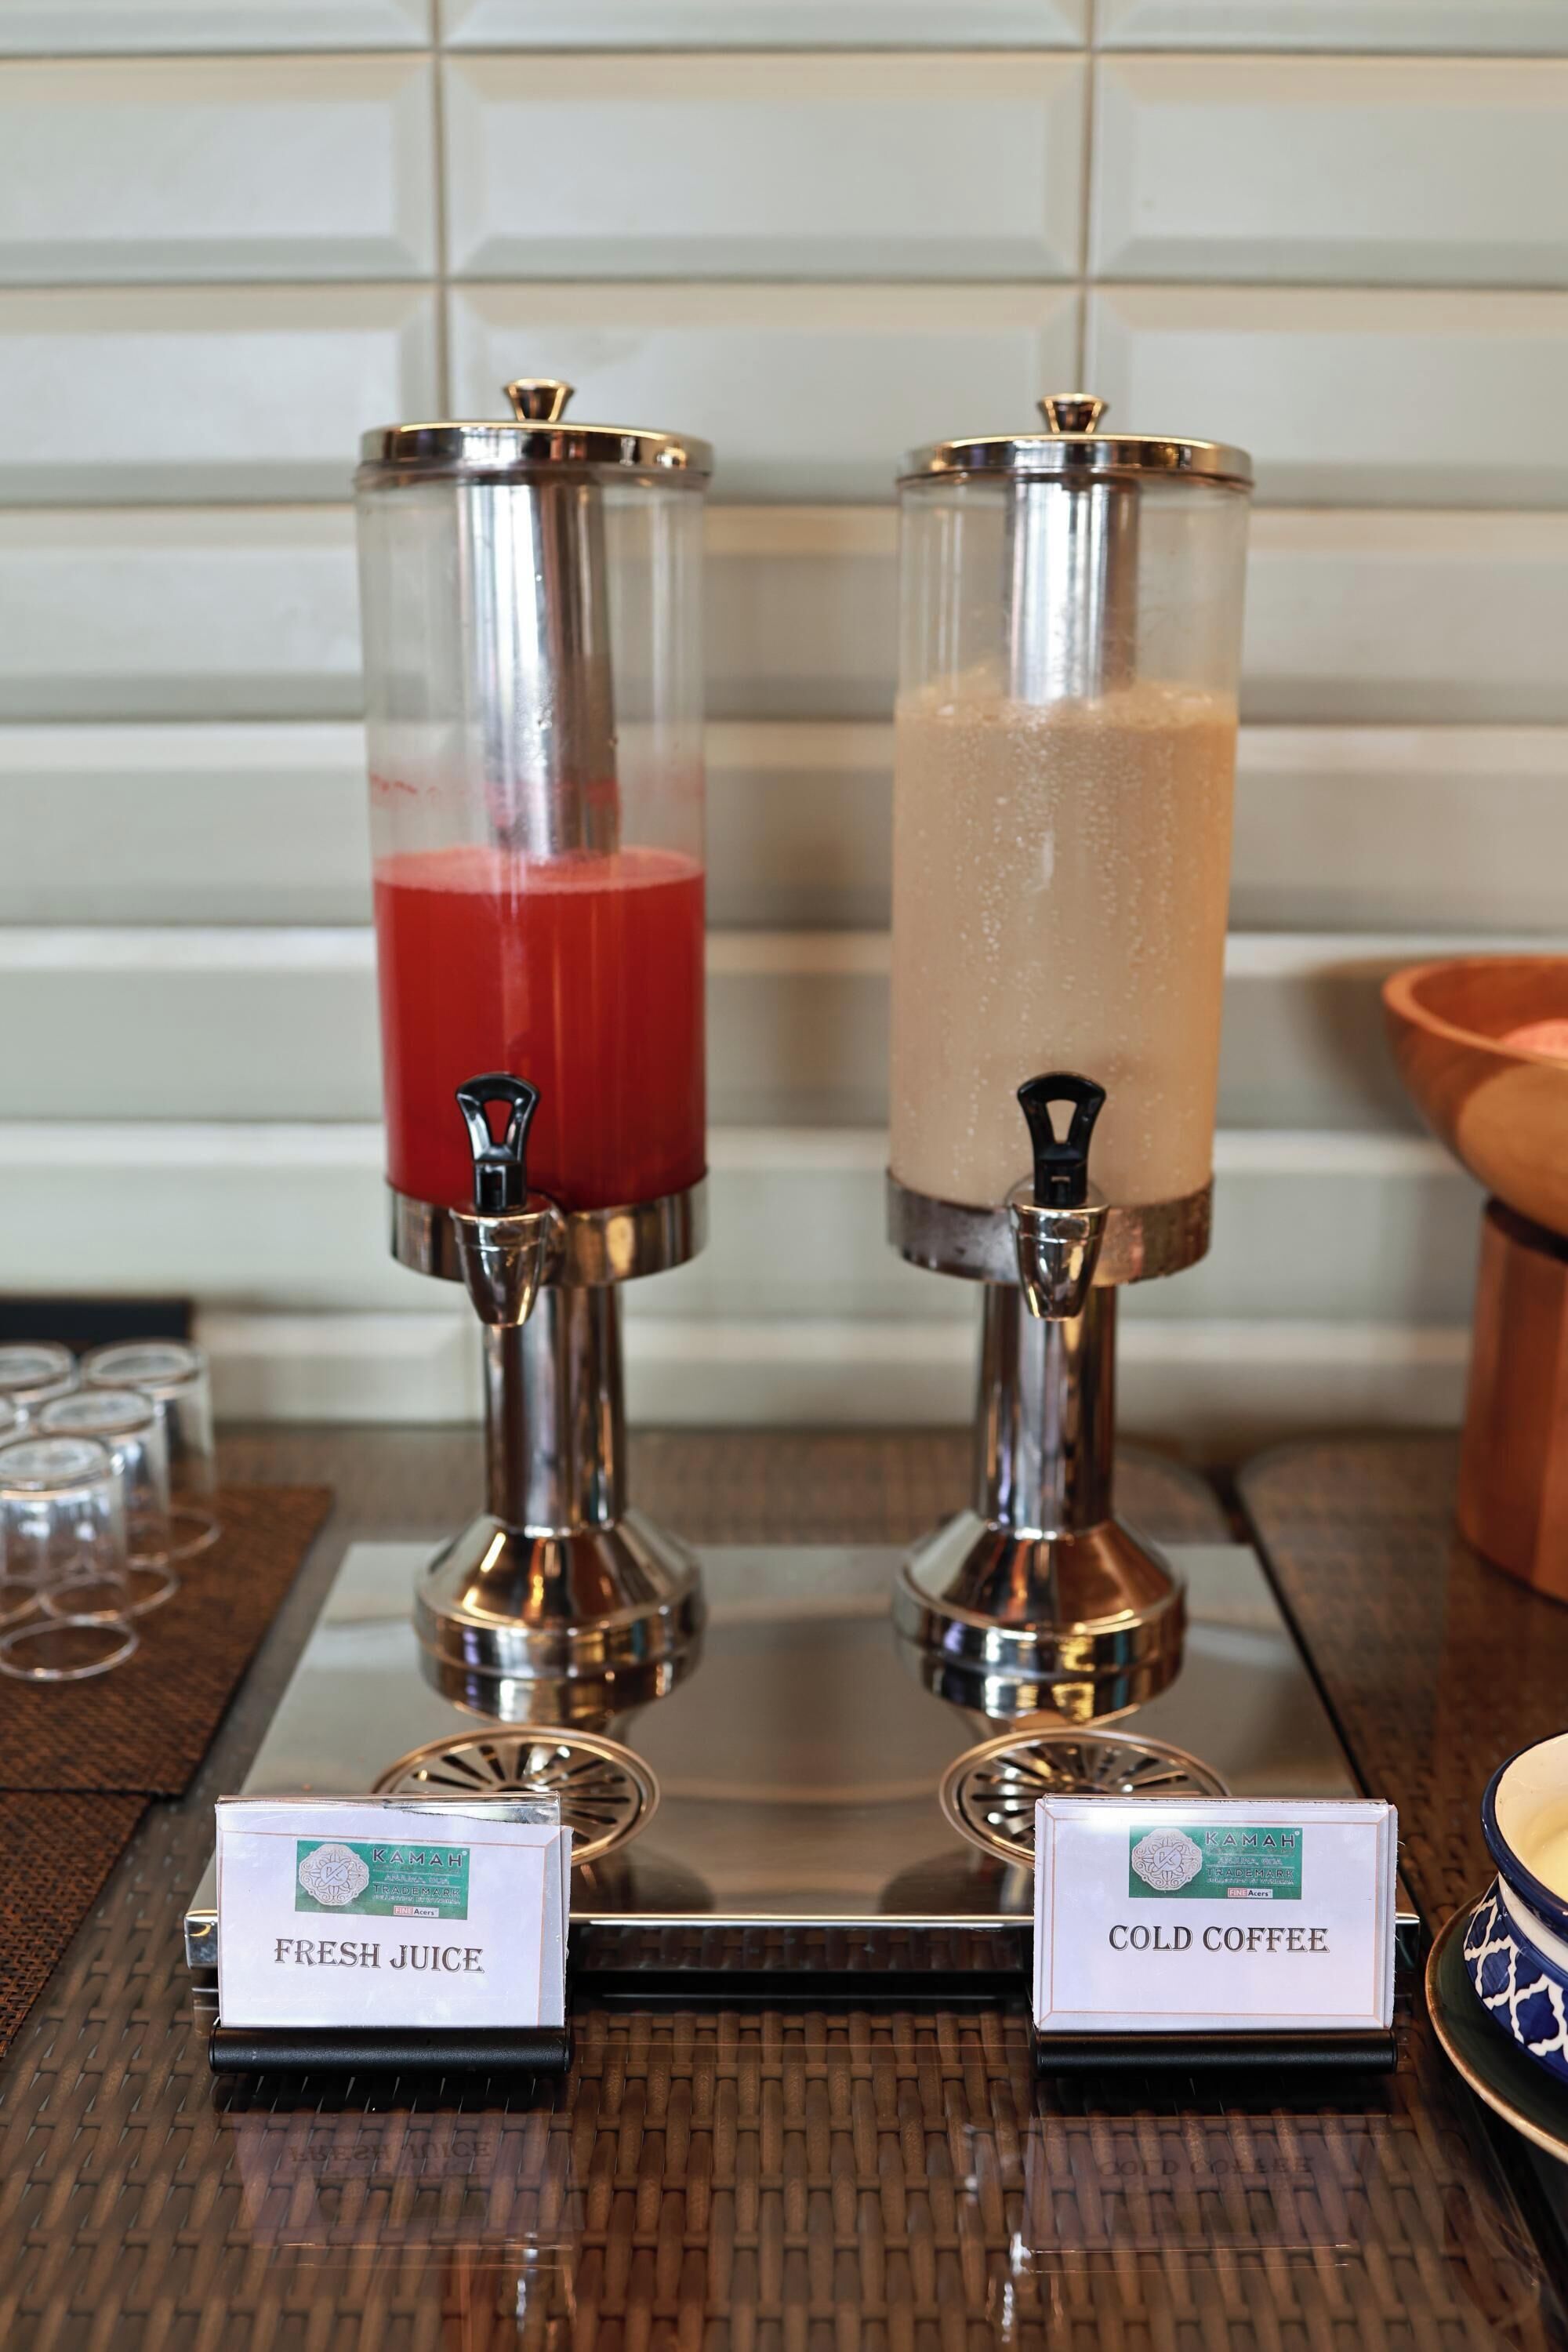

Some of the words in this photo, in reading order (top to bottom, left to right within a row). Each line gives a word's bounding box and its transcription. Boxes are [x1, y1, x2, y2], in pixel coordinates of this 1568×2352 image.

[1205, 1831, 1295, 1848] KAMAH
[372, 1848, 463, 1867] KAMAH
[1207, 1867, 1294, 1878] TRADEMARK
[373, 1884, 461, 1898] TRADEMARK
[413, 1907, 434, 1916] Acers
[1109, 1925, 1193, 1951] COLD
[1203, 1926, 1330, 1953] COFFEE
[274, 1938, 382, 1969] FRESH
[389, 1944, 485, 1974] JUICE
